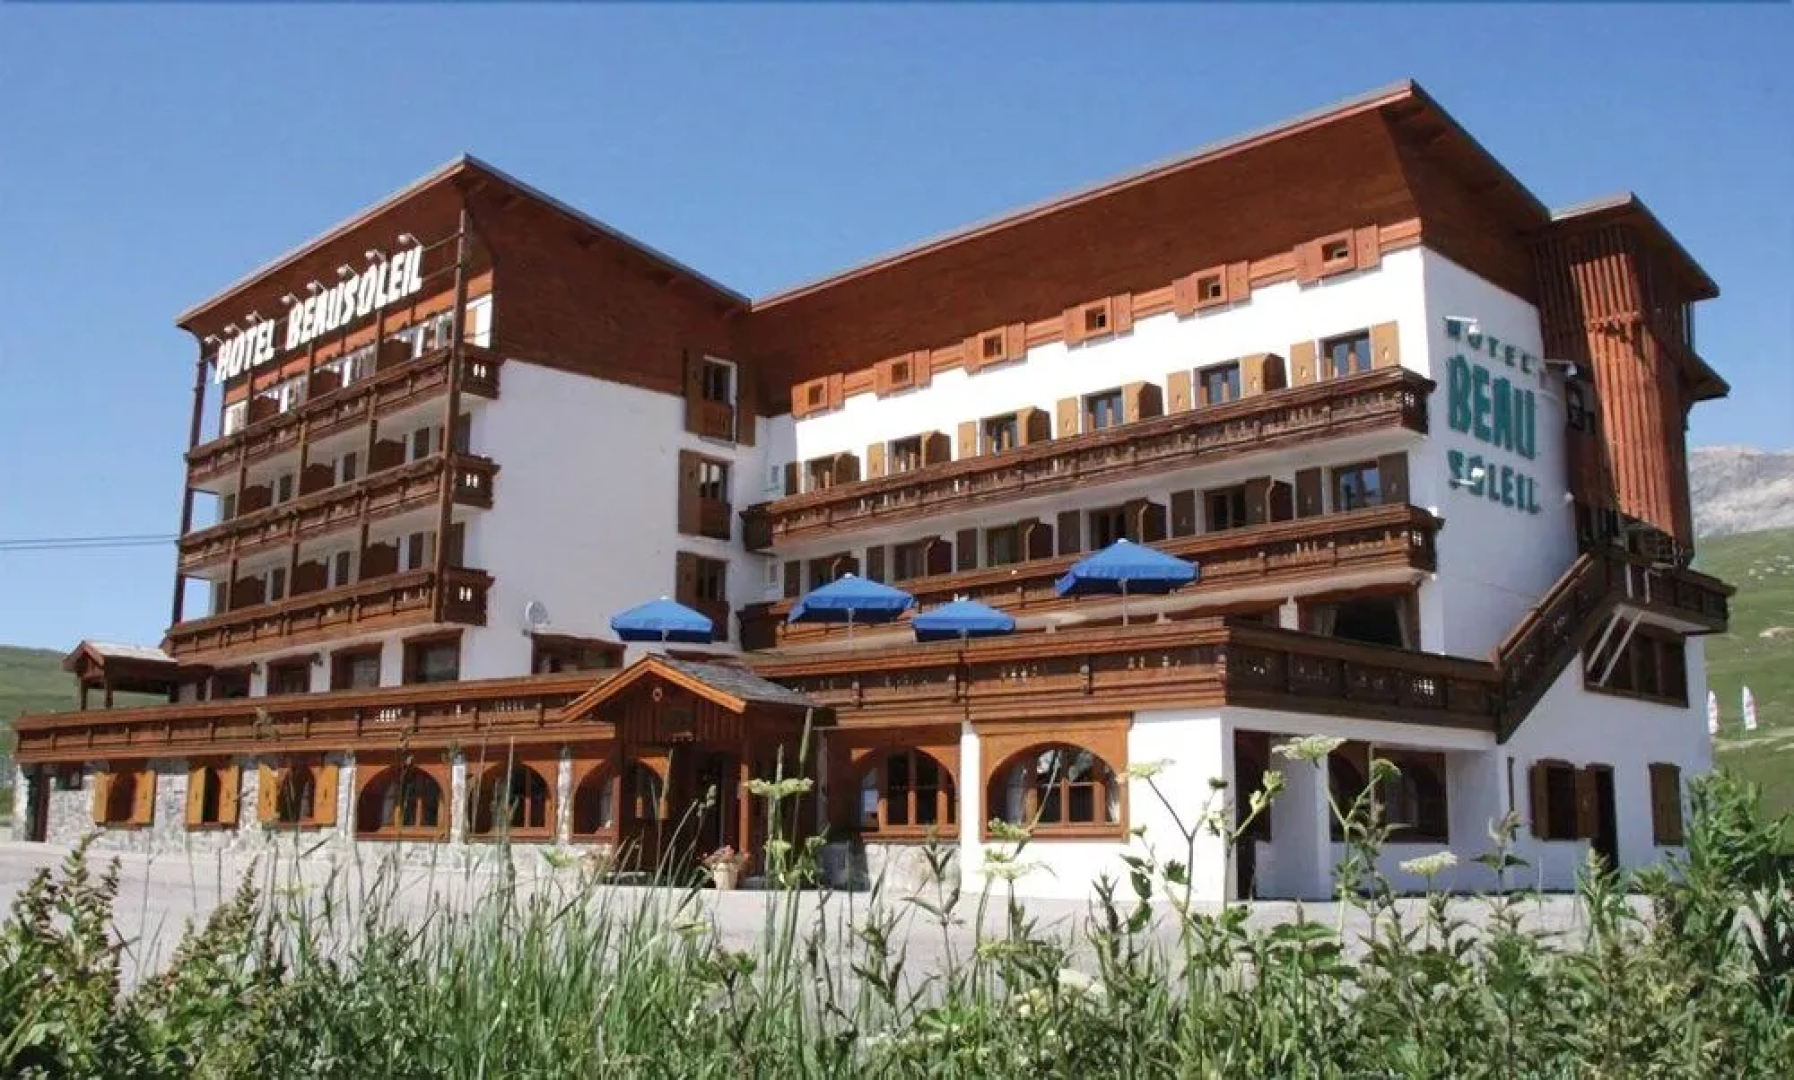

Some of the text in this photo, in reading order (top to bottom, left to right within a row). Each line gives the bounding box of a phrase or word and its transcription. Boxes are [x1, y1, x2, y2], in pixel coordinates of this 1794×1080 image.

[215, 246, 423, 384] HOTEL BEAUSOLEIL
[1446, 354, 1536, 460] BEAU
[1447, 449, 1541, 514] SOLEIL
